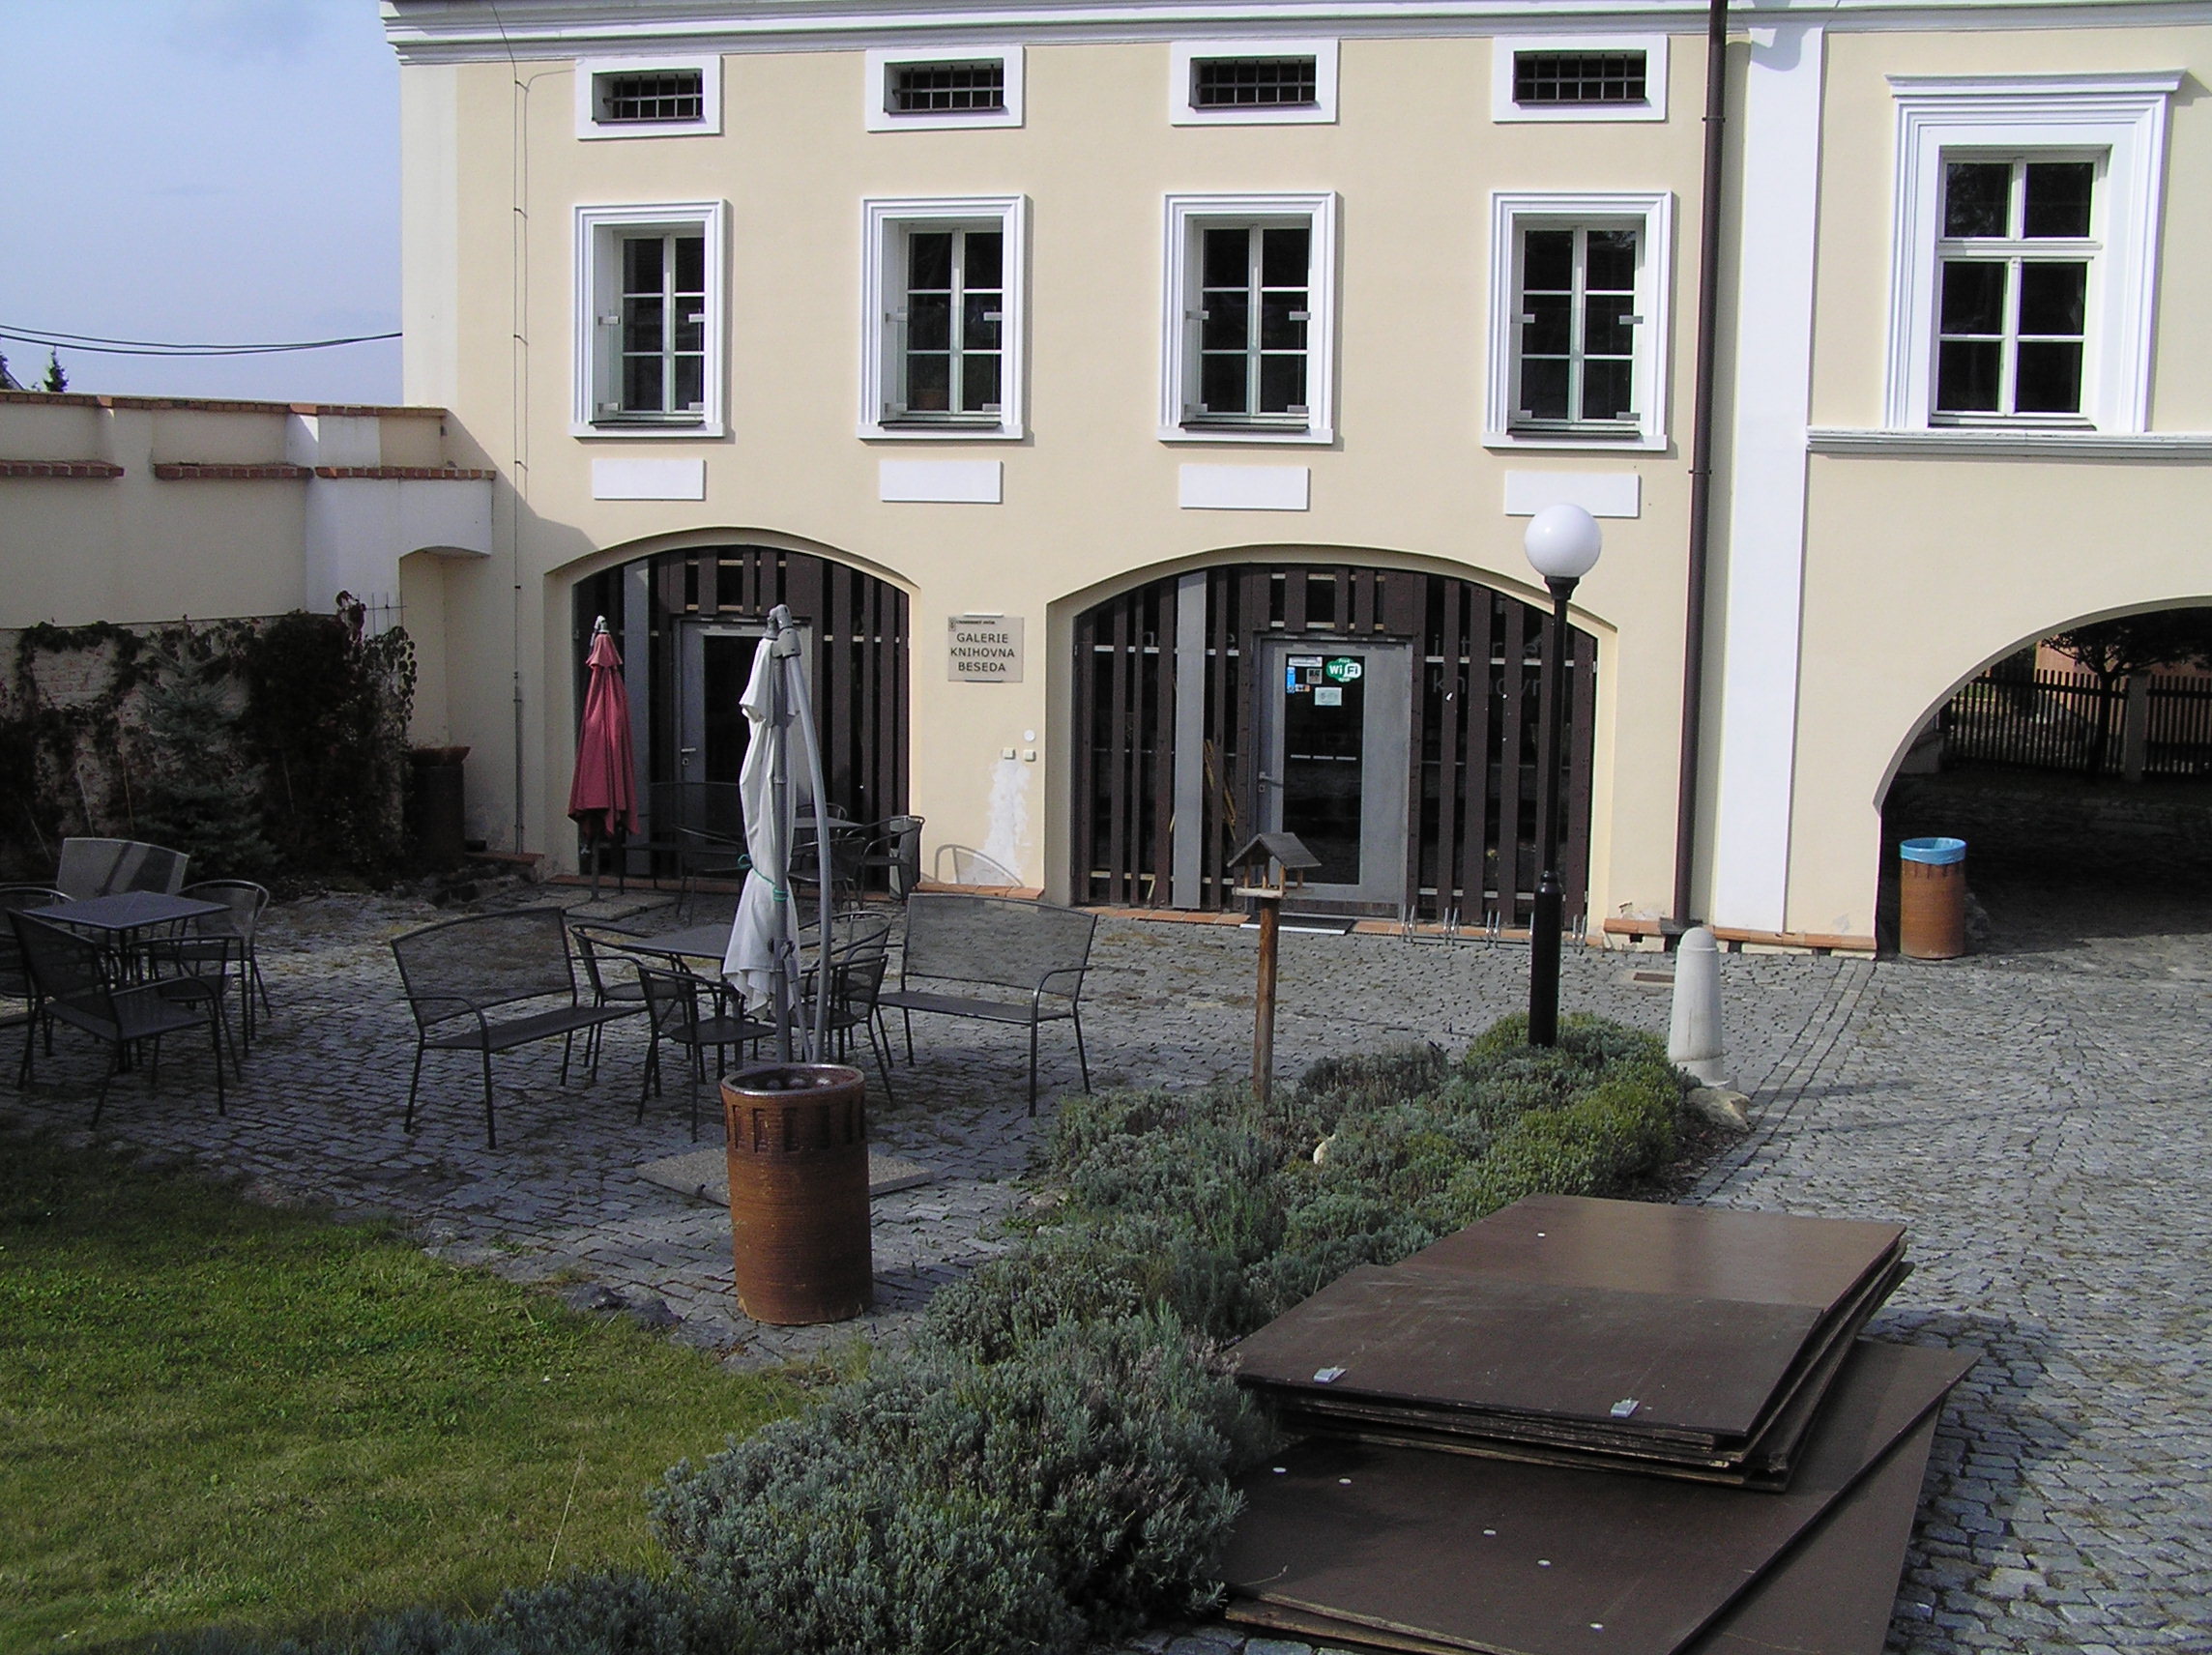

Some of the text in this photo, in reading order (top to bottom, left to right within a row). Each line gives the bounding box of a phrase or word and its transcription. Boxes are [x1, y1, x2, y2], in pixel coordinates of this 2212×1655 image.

[957, 632, 1009, 644] GALERIE
[950, 647, 1015, 658] KNIHOVNA
[958, 661, 1006, 673] BESEDA
